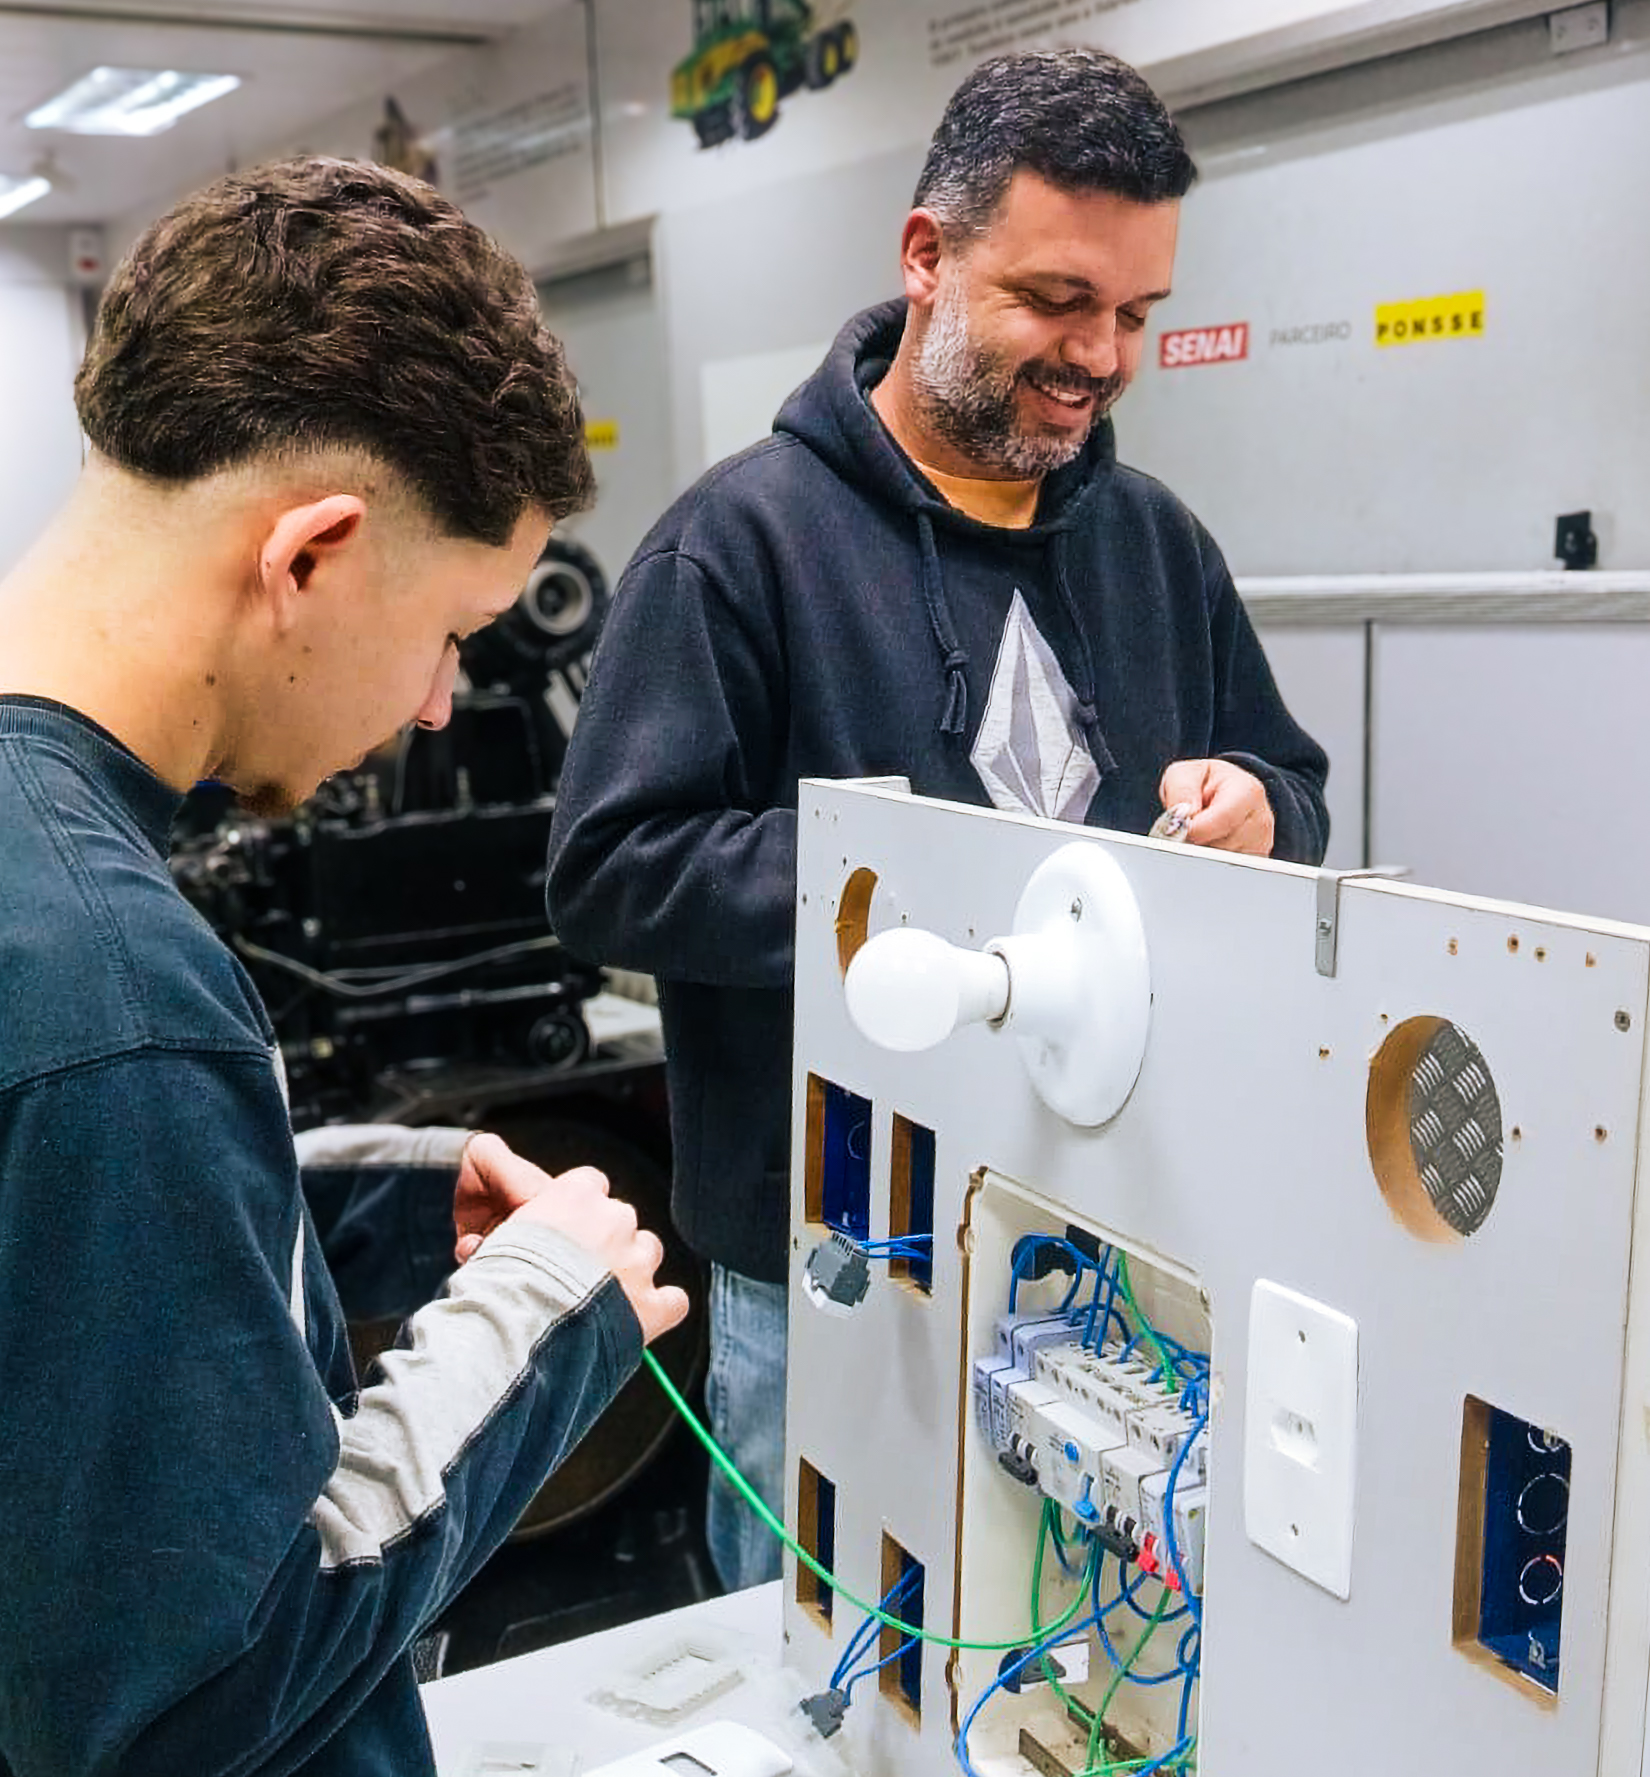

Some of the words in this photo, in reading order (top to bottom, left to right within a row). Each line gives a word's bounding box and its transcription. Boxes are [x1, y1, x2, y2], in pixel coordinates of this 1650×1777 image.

[1163, 327, 1244, 366] SENAI
[1270, 321, 1351, 347] PARCEIRO
[1376, 311, 1484, 341] PONSSE
